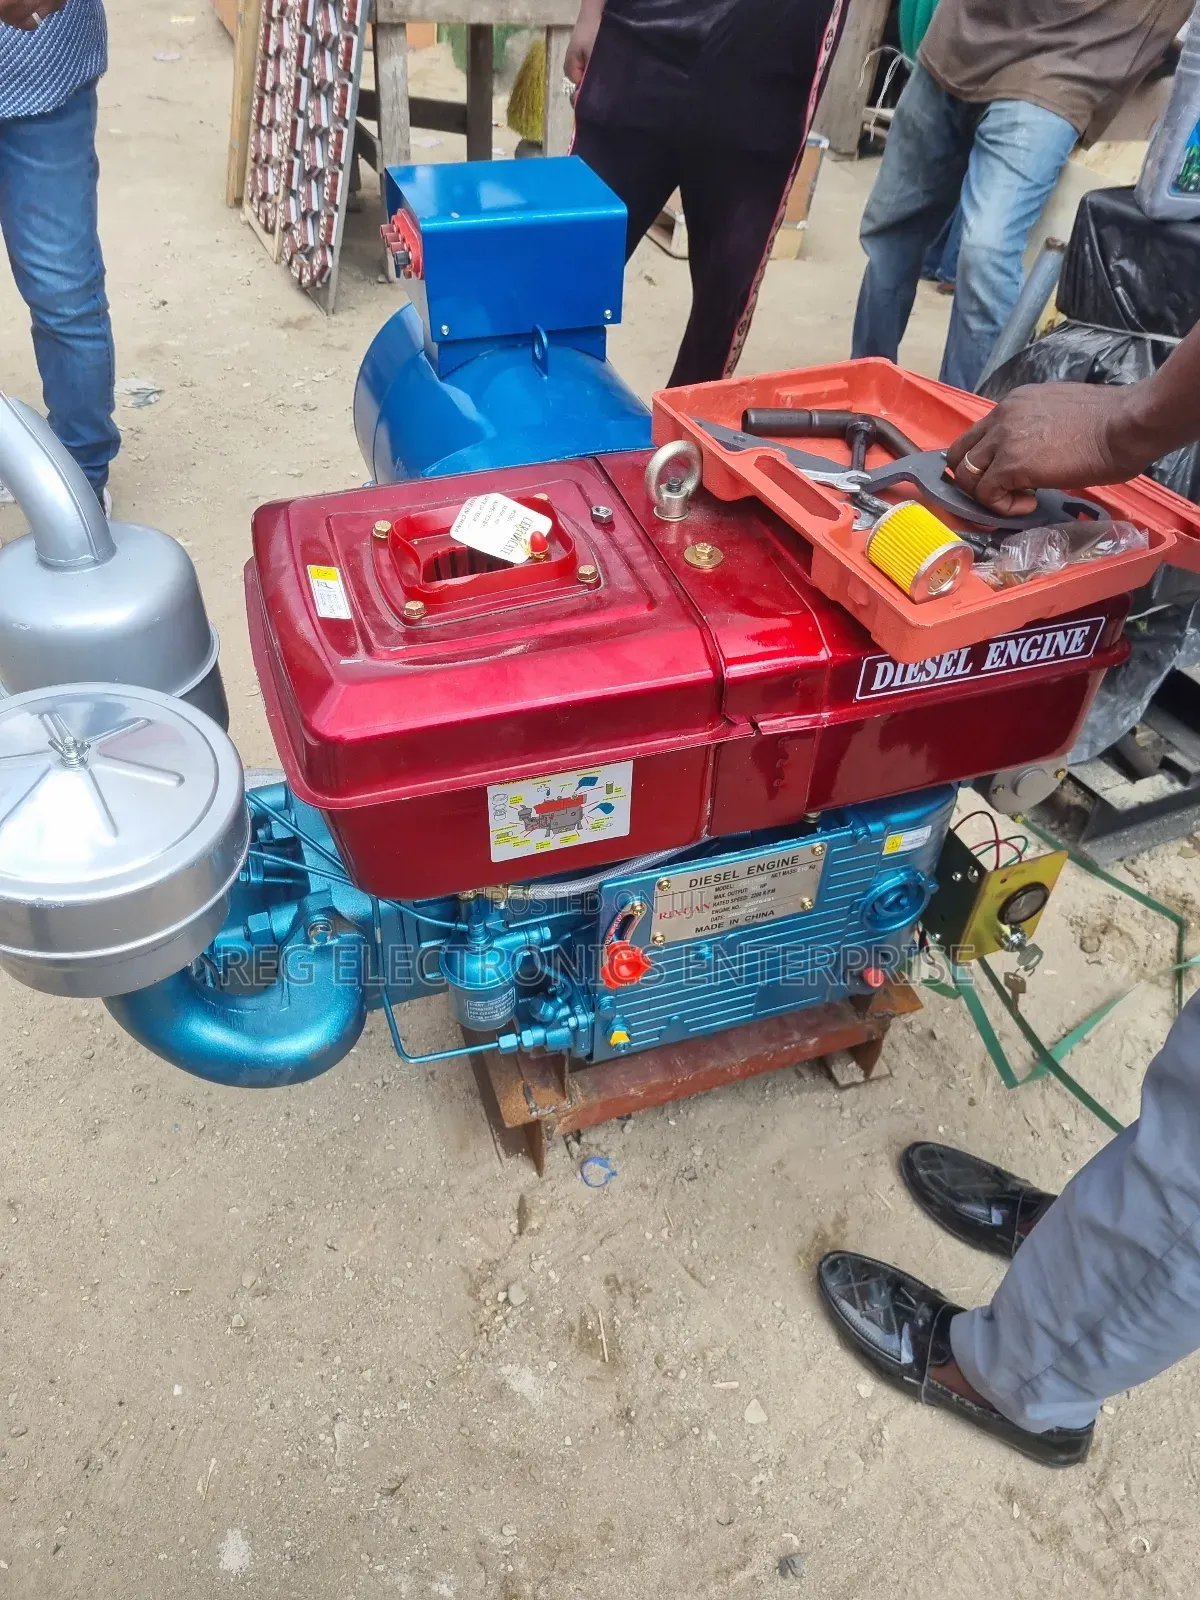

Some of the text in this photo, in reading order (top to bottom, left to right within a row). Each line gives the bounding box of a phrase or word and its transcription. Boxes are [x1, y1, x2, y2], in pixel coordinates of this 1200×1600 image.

[871, 625, 1091, 690] DIESEL ENGINE
[689, 870, 740, 888] DIESEL
[746, 854, 800, 875] ENGINE
[695, 922, 724, 933] MADE
[745, 910, 775, 921] CHINA
